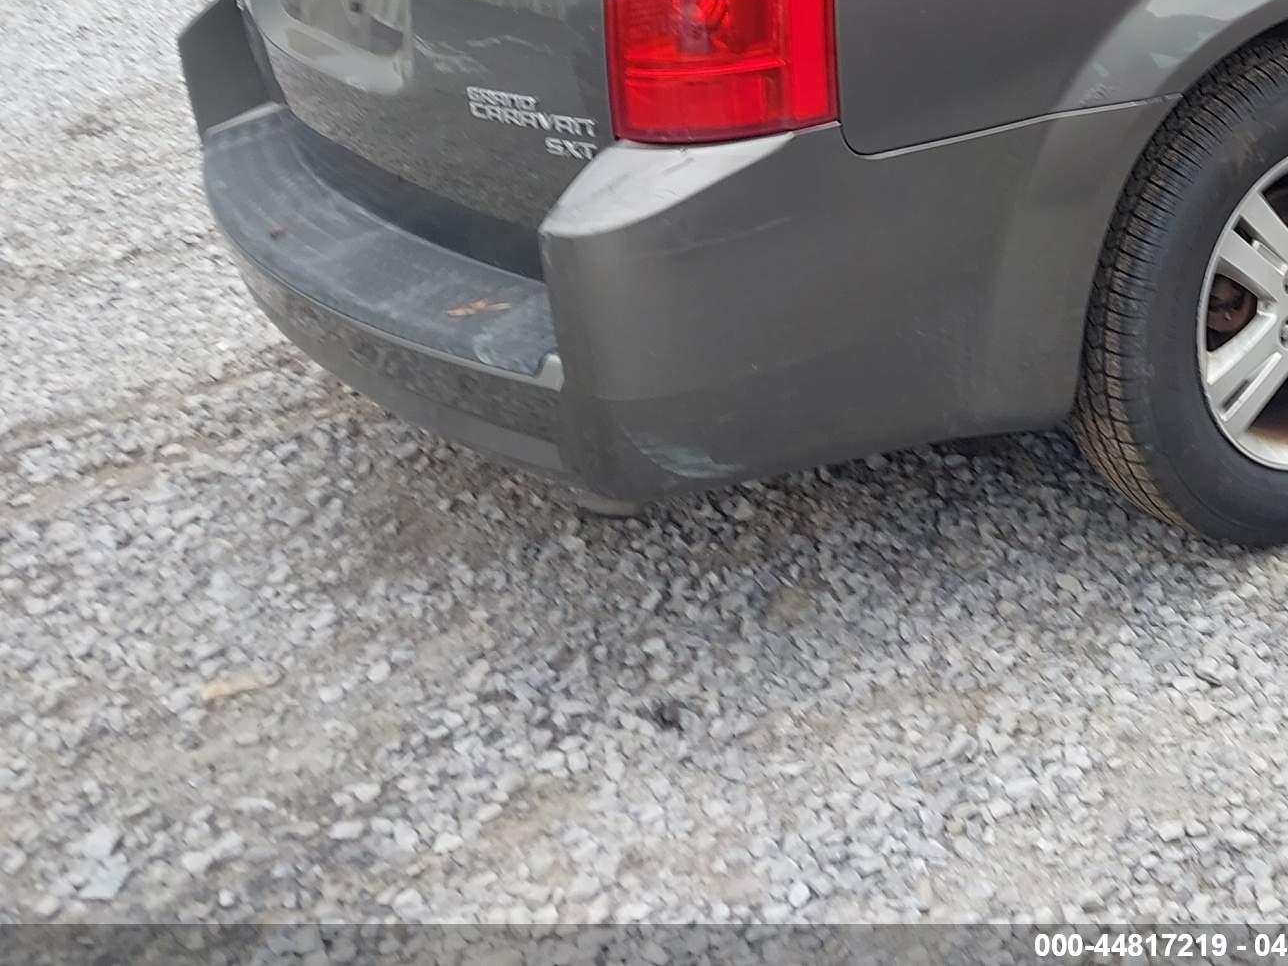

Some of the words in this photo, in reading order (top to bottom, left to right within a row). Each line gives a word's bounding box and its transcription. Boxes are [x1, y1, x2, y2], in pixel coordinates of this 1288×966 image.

[467, 86, 536, 111] GRAND
[469, 102, 597, 137] CARAVAN
[545, 137, 598, 160] SXT
